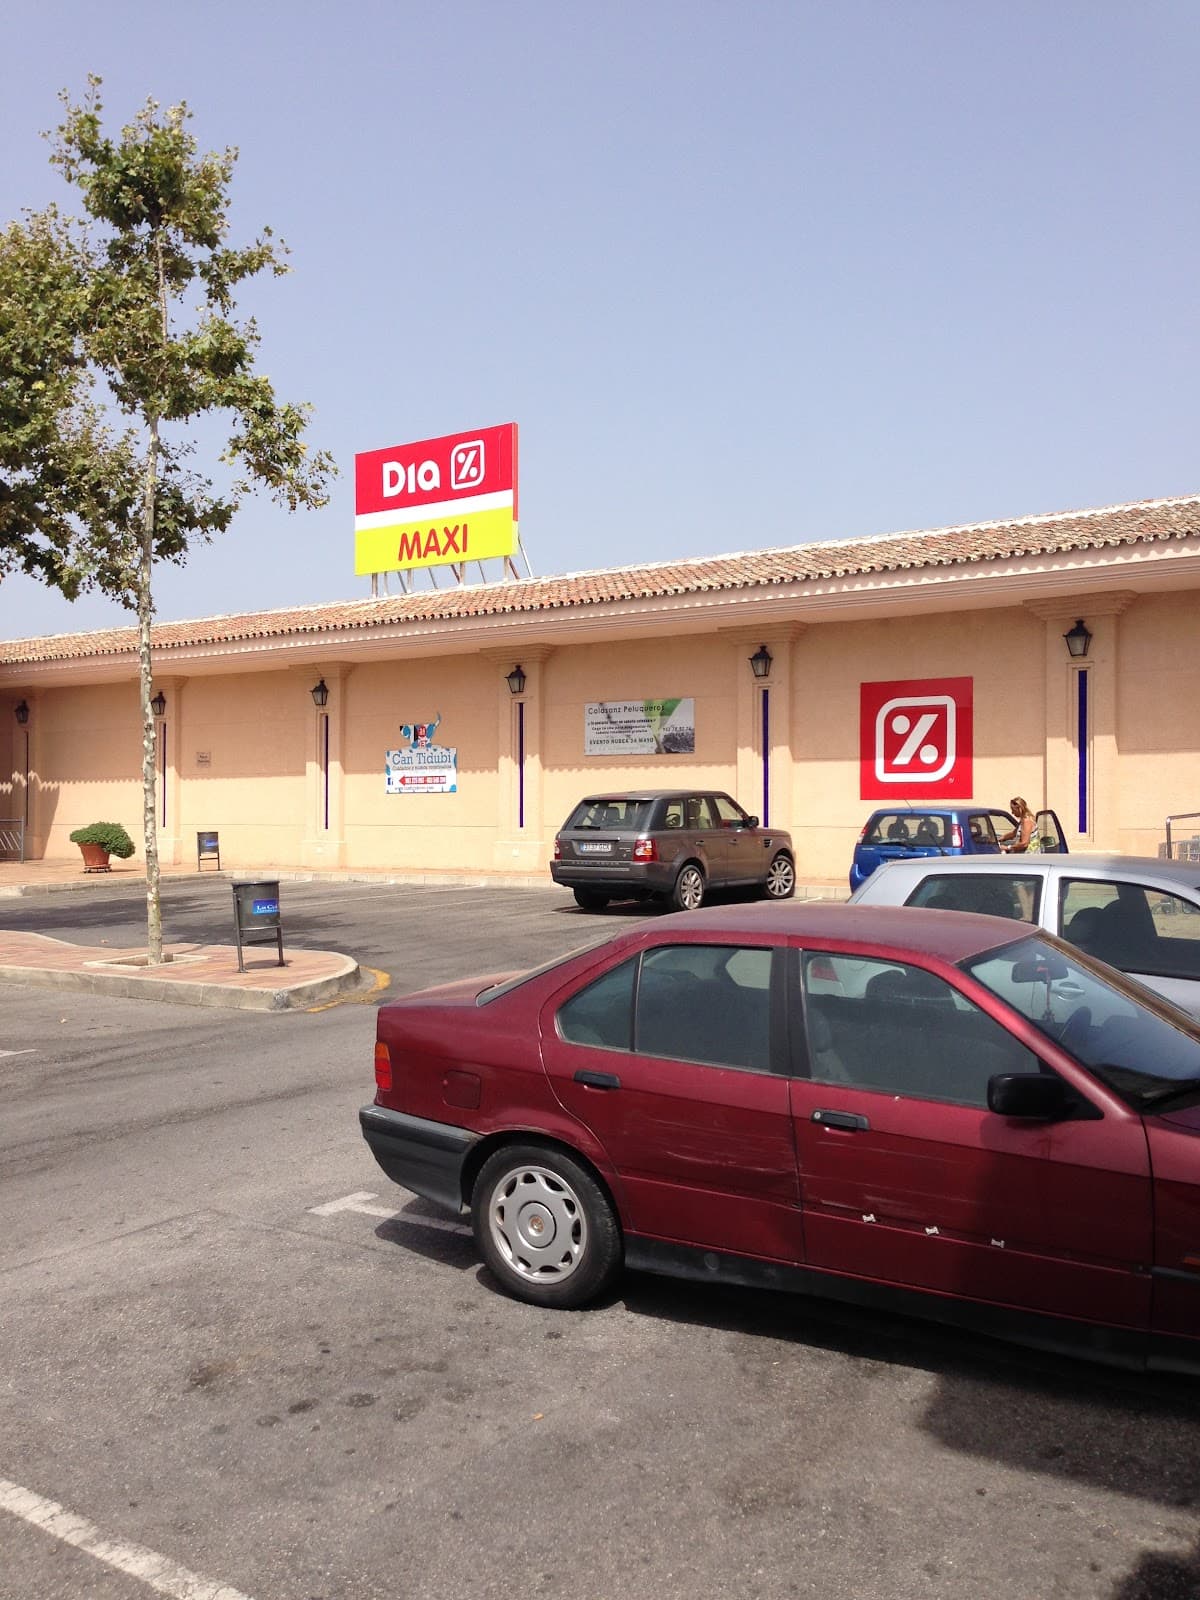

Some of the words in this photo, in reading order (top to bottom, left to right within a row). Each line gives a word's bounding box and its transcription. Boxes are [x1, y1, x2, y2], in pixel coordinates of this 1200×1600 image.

[398, 523, 468, 562] MAXI
[623, 705, 665, 713] Peluqueros
[392, 753, 413, 765] Can
[416, 752, 452, 765] Tidubi
